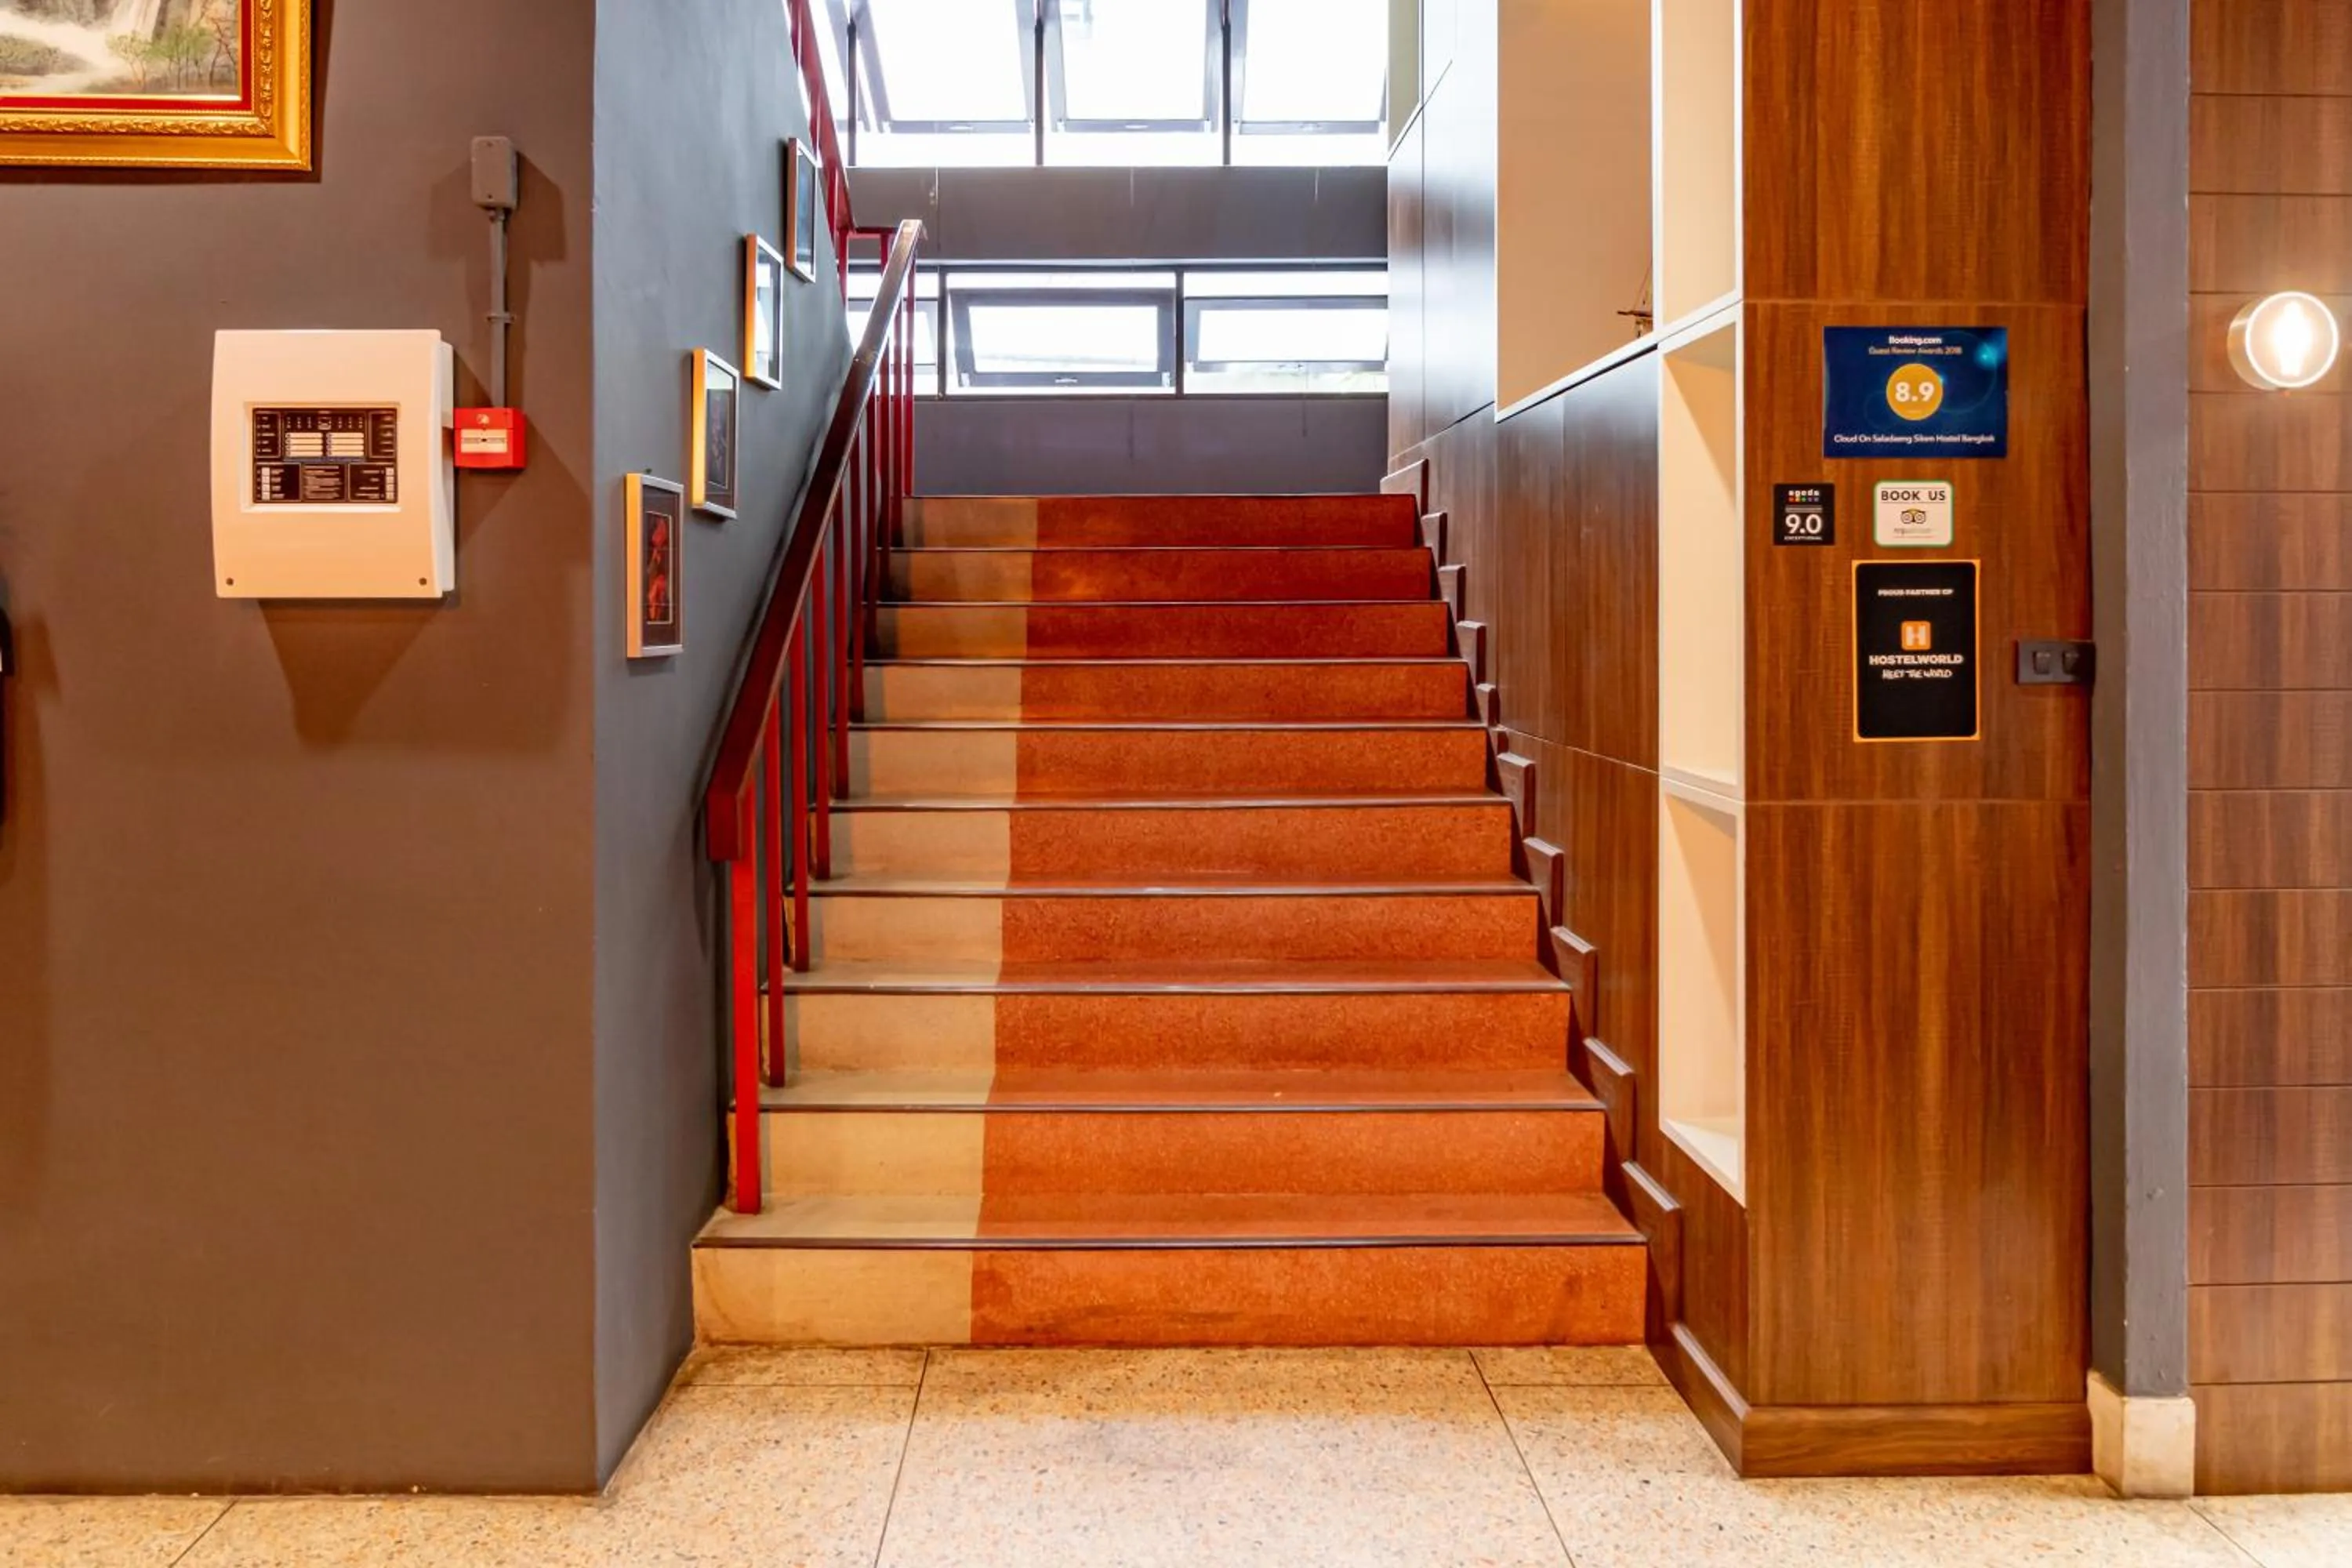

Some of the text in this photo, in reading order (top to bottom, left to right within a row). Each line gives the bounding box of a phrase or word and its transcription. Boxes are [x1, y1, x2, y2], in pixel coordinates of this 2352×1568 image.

[1889, 335, 1943, 346] Booking.com
[1895, 382, 1934, 402] 8.9
[1834, 433, 1857, 443] Cloud
[1859, 433, 1871, 443] On
[1788, 488, 1820, 497] agoda
[1881, 490, 1946, 501] BOOK US
[1785, 514, 1823, 534] 9.0
[1868, 654, 1964, 666] HOSTELWORLD
